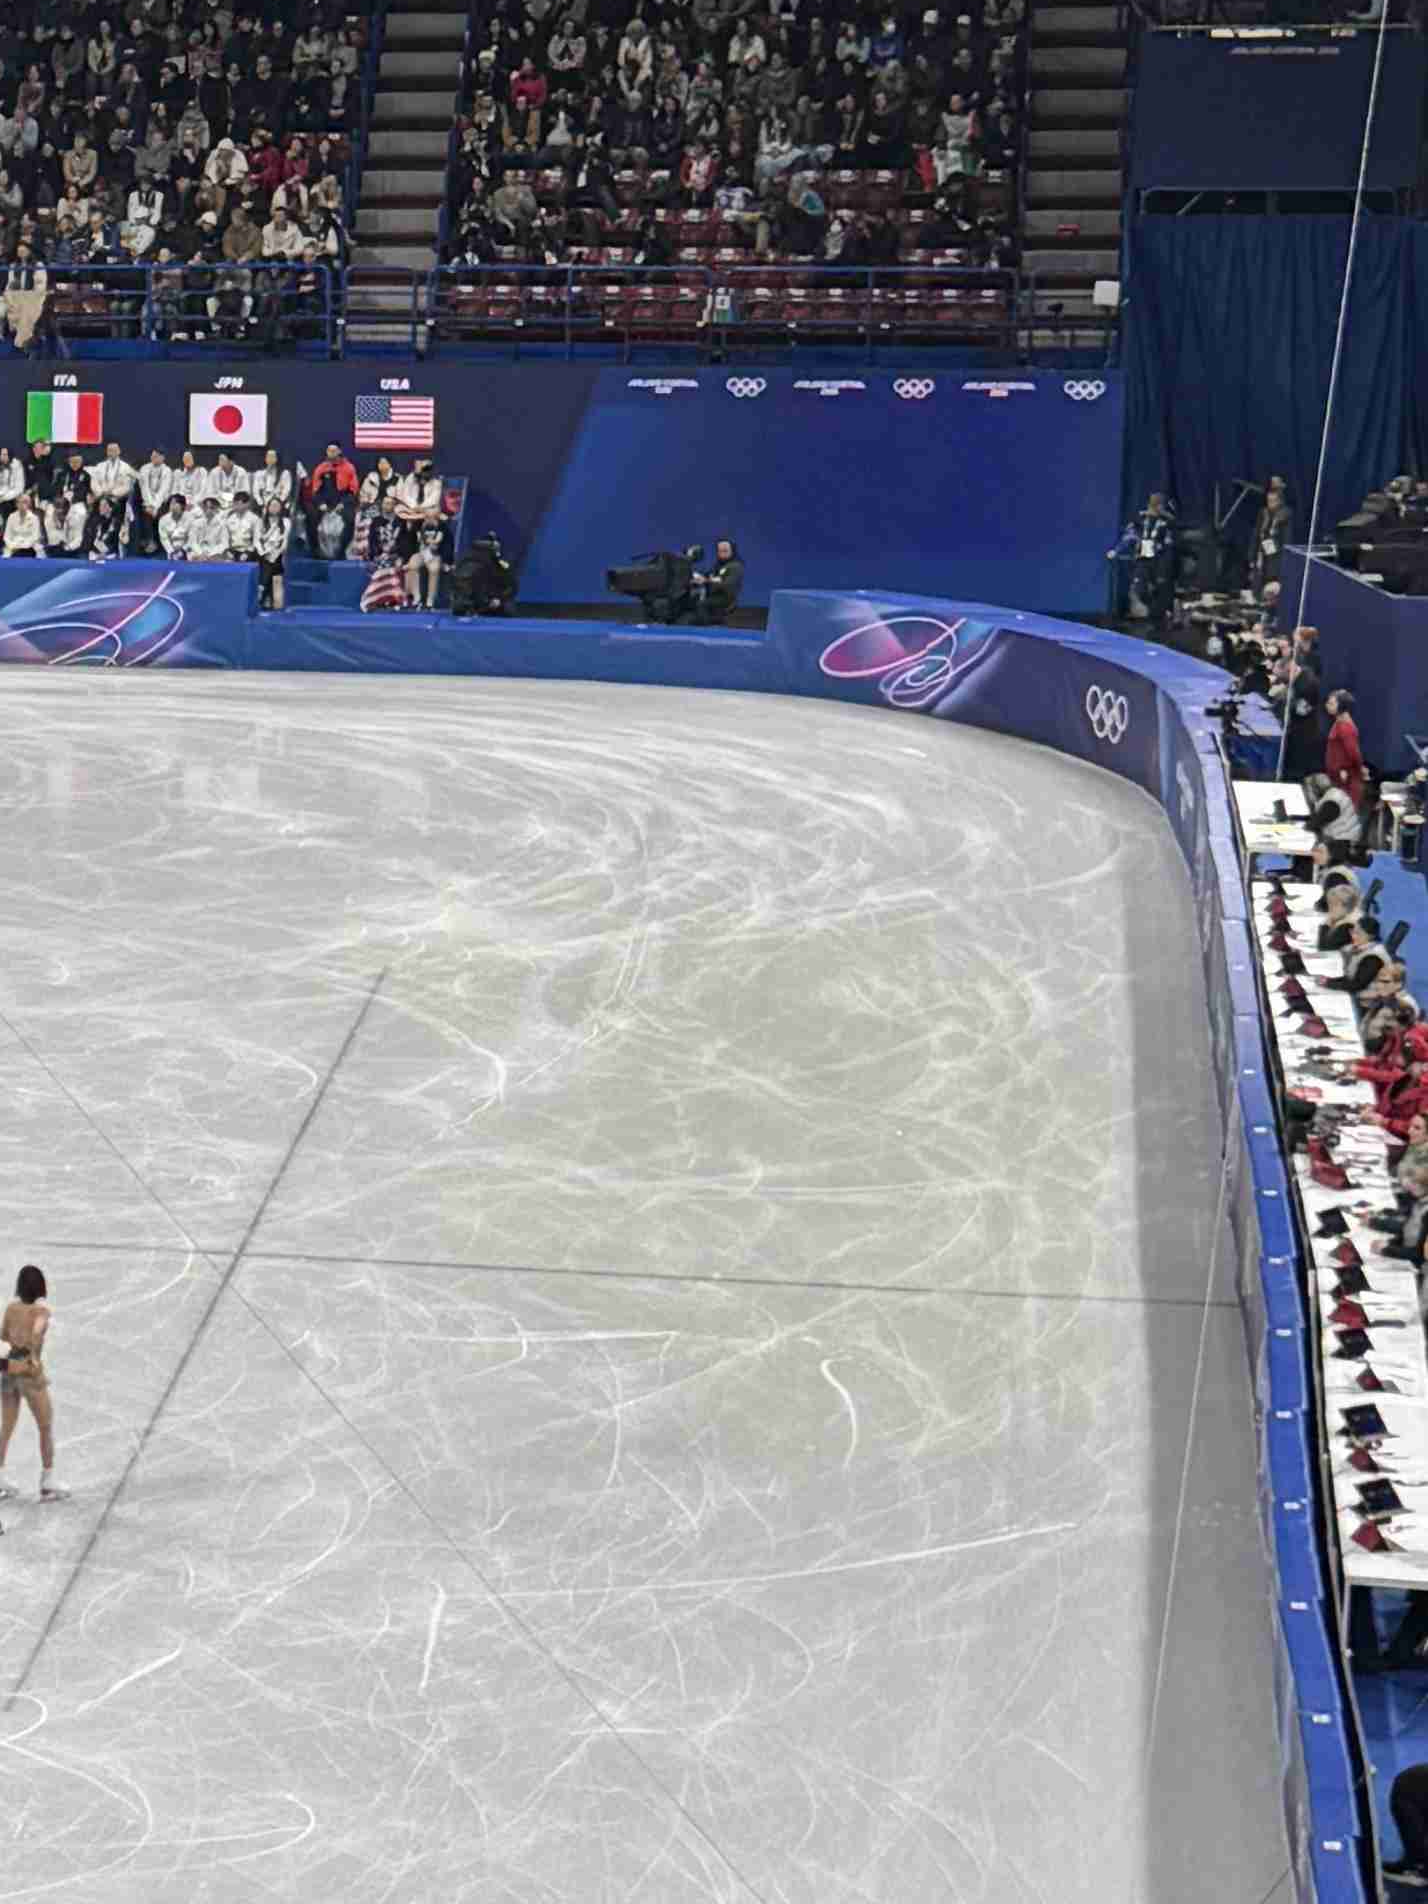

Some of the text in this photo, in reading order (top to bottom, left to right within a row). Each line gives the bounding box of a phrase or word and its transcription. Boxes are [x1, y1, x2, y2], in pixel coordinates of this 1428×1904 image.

[53, 374, 77, 386] ITA
[213, 376, 244, 389] JPN
[380, 378, 410, 390] USA
